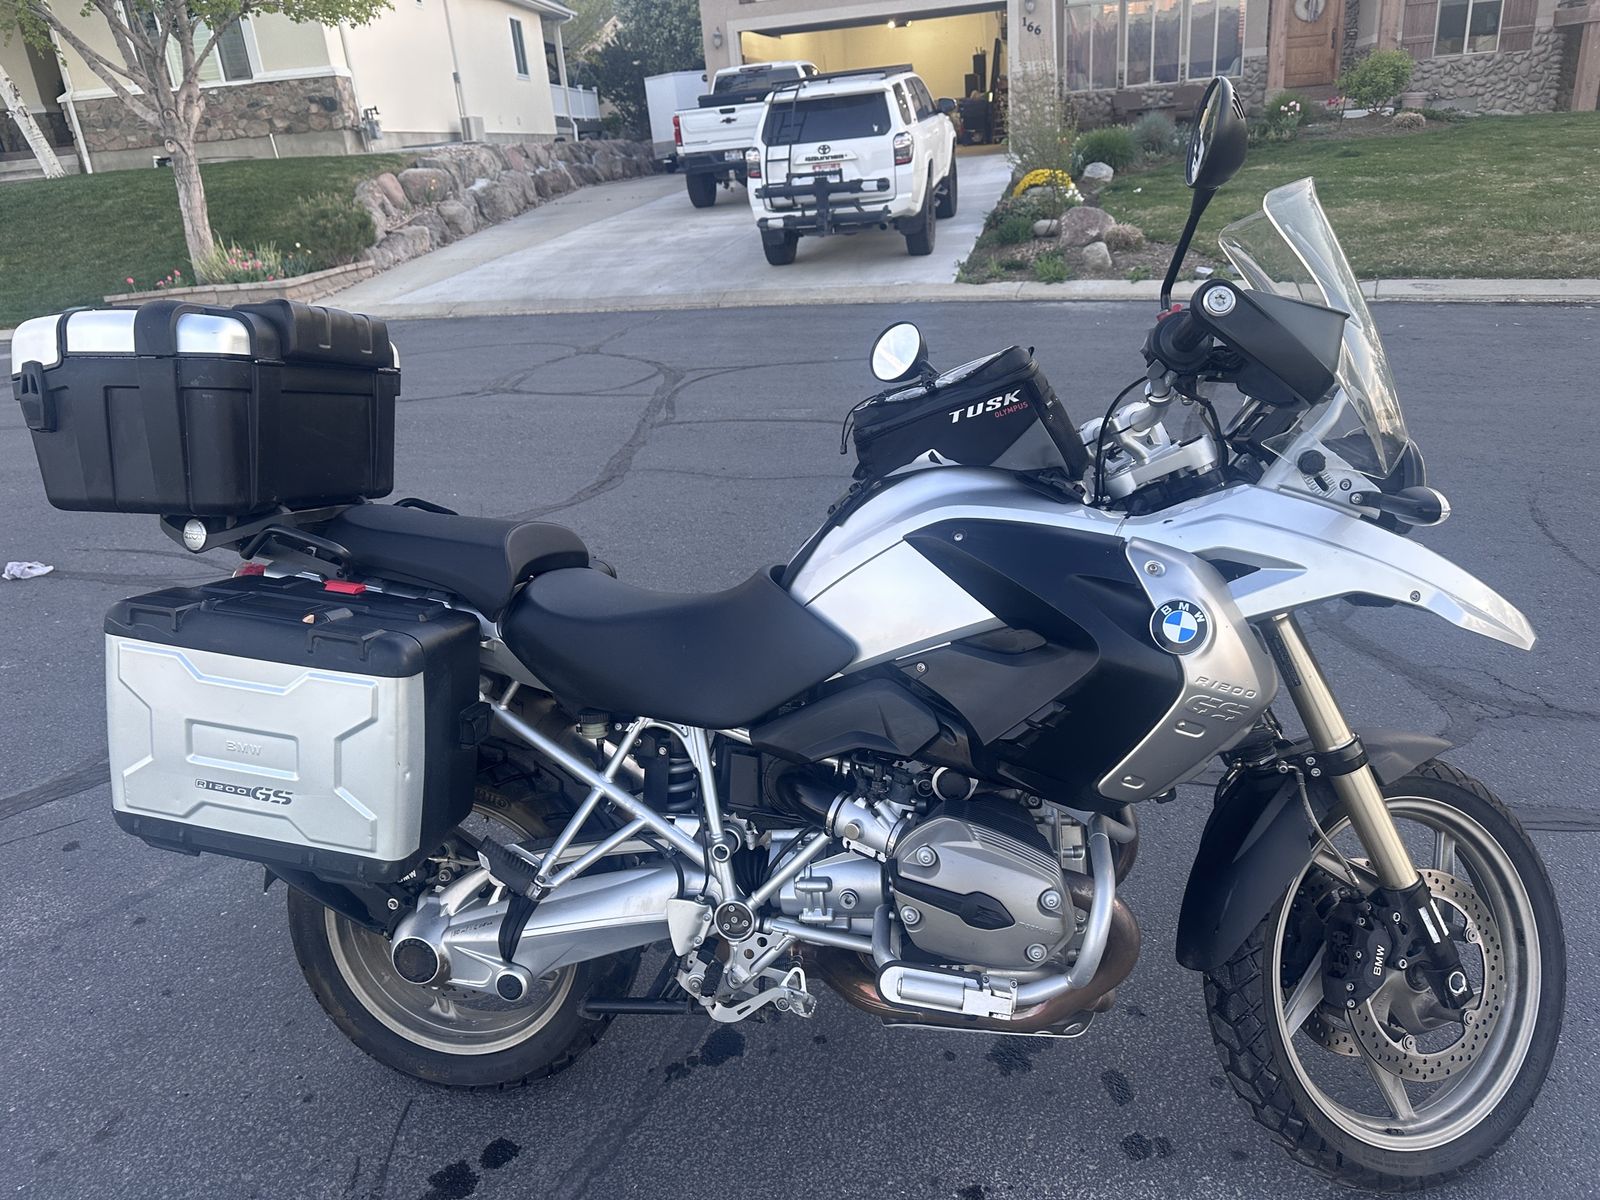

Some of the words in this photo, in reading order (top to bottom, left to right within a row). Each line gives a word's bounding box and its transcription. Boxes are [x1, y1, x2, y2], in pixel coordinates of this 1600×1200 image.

[1022, 16, 1041, 35] 166
[948, 389, 1021, 424] TUSK
[994, 401, 1029, 418] OLYMPUS
[1160, 601, 1206, 623] BMW
[225, 740, 263, 756] BMW
[1373, 944, 1385, 976] BMW
